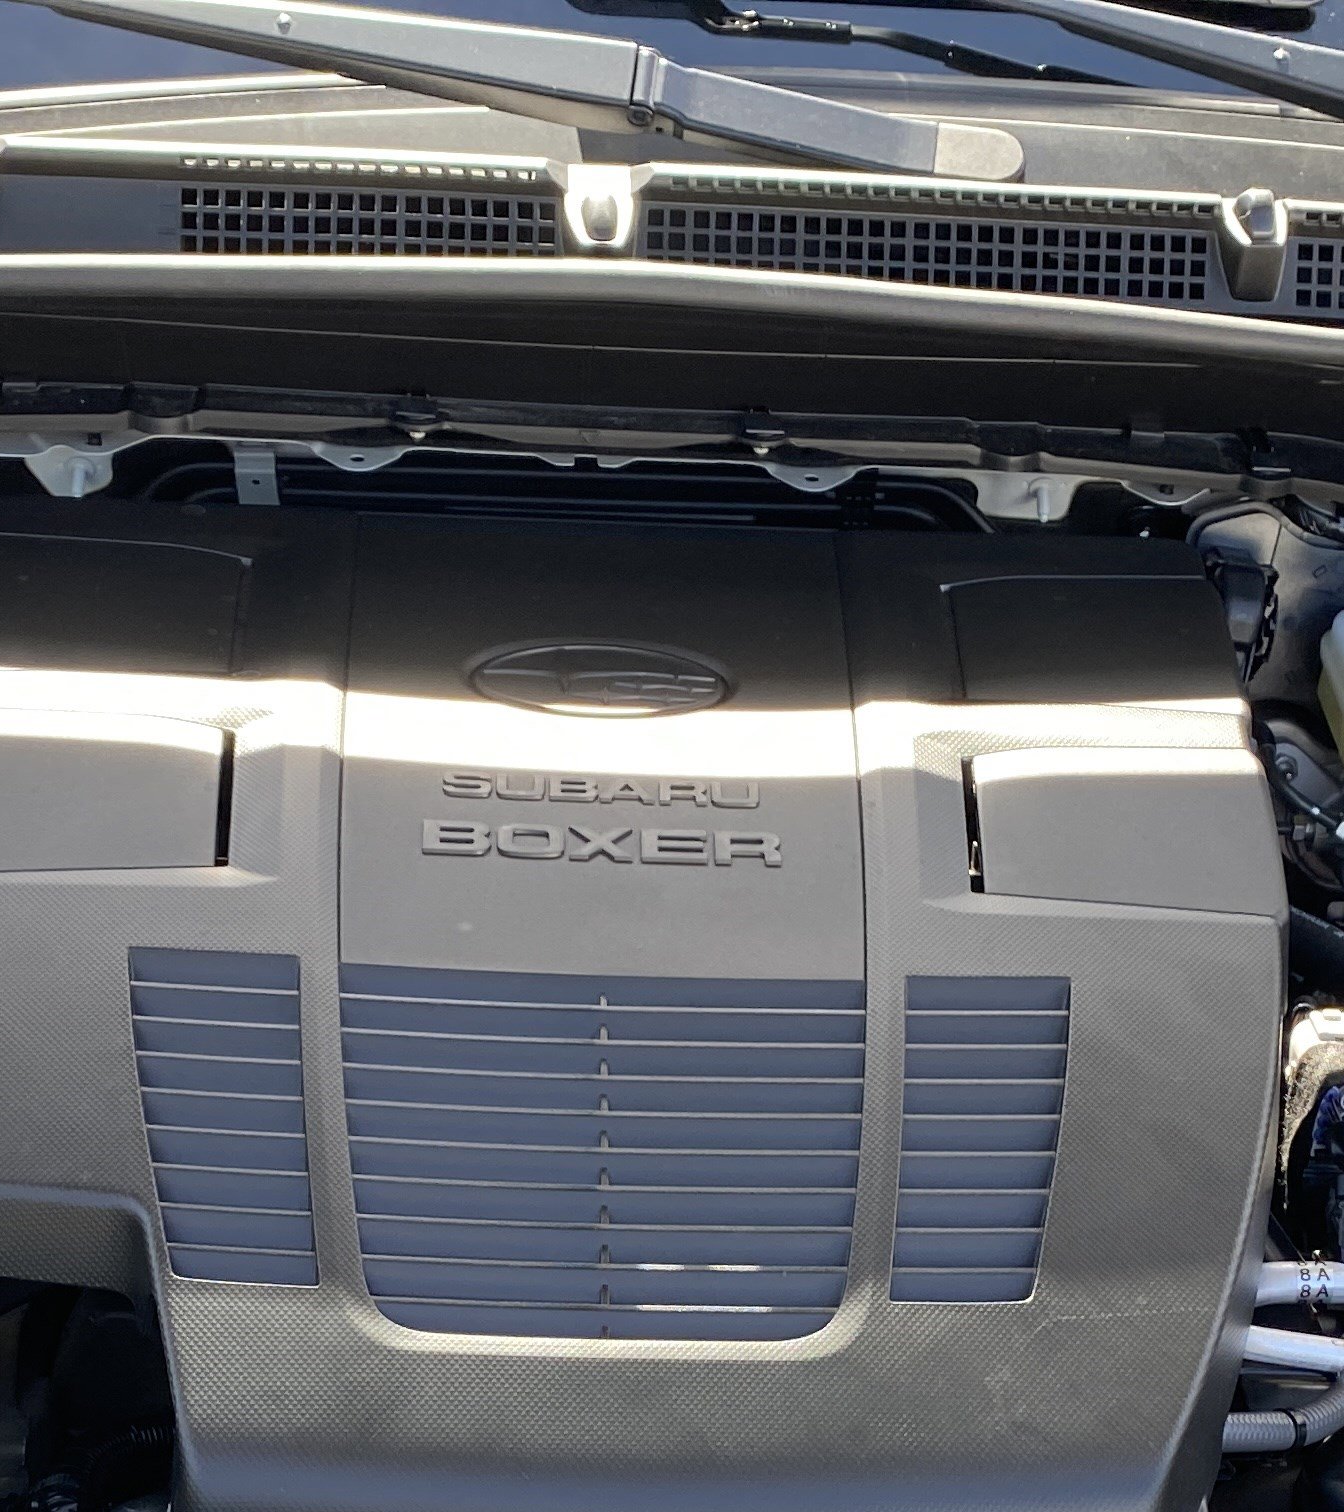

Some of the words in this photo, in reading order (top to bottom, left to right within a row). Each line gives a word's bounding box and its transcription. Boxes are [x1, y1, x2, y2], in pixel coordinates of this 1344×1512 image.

[442, 771, 761, 809] SUBARU
[421, 818, 782, 868] BOXER
[1299, 1268, 1312, 1282] 8
[1316, 1267, 1331, 1282] A
[1299, 1283, 1312, 1298] 8
[1315, 1283, 1329, 1298] A
